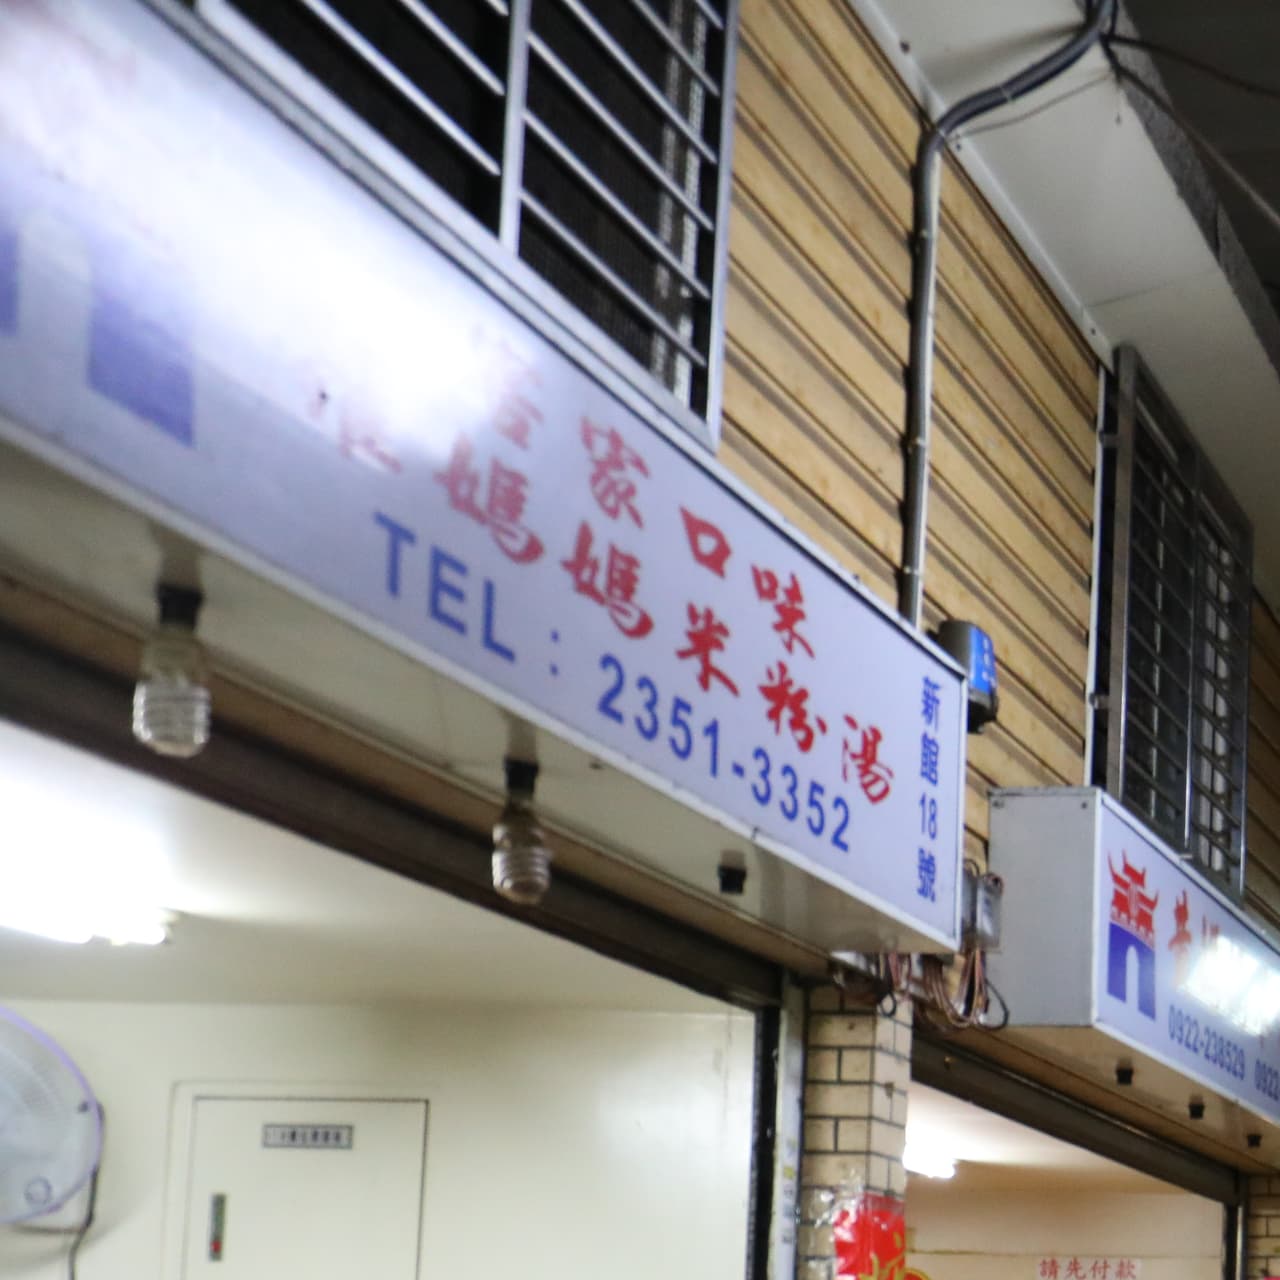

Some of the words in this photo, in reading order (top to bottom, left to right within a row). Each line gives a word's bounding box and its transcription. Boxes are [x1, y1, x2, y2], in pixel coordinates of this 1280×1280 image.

[338, 400, 894, 804] 媽媽米粉湯
[600, 655, 851, 853] 2351-3352
[1168, 1004, 1246, 1081] 0922-238529
[1039, 1258, 1138, 1280] 請先付款
